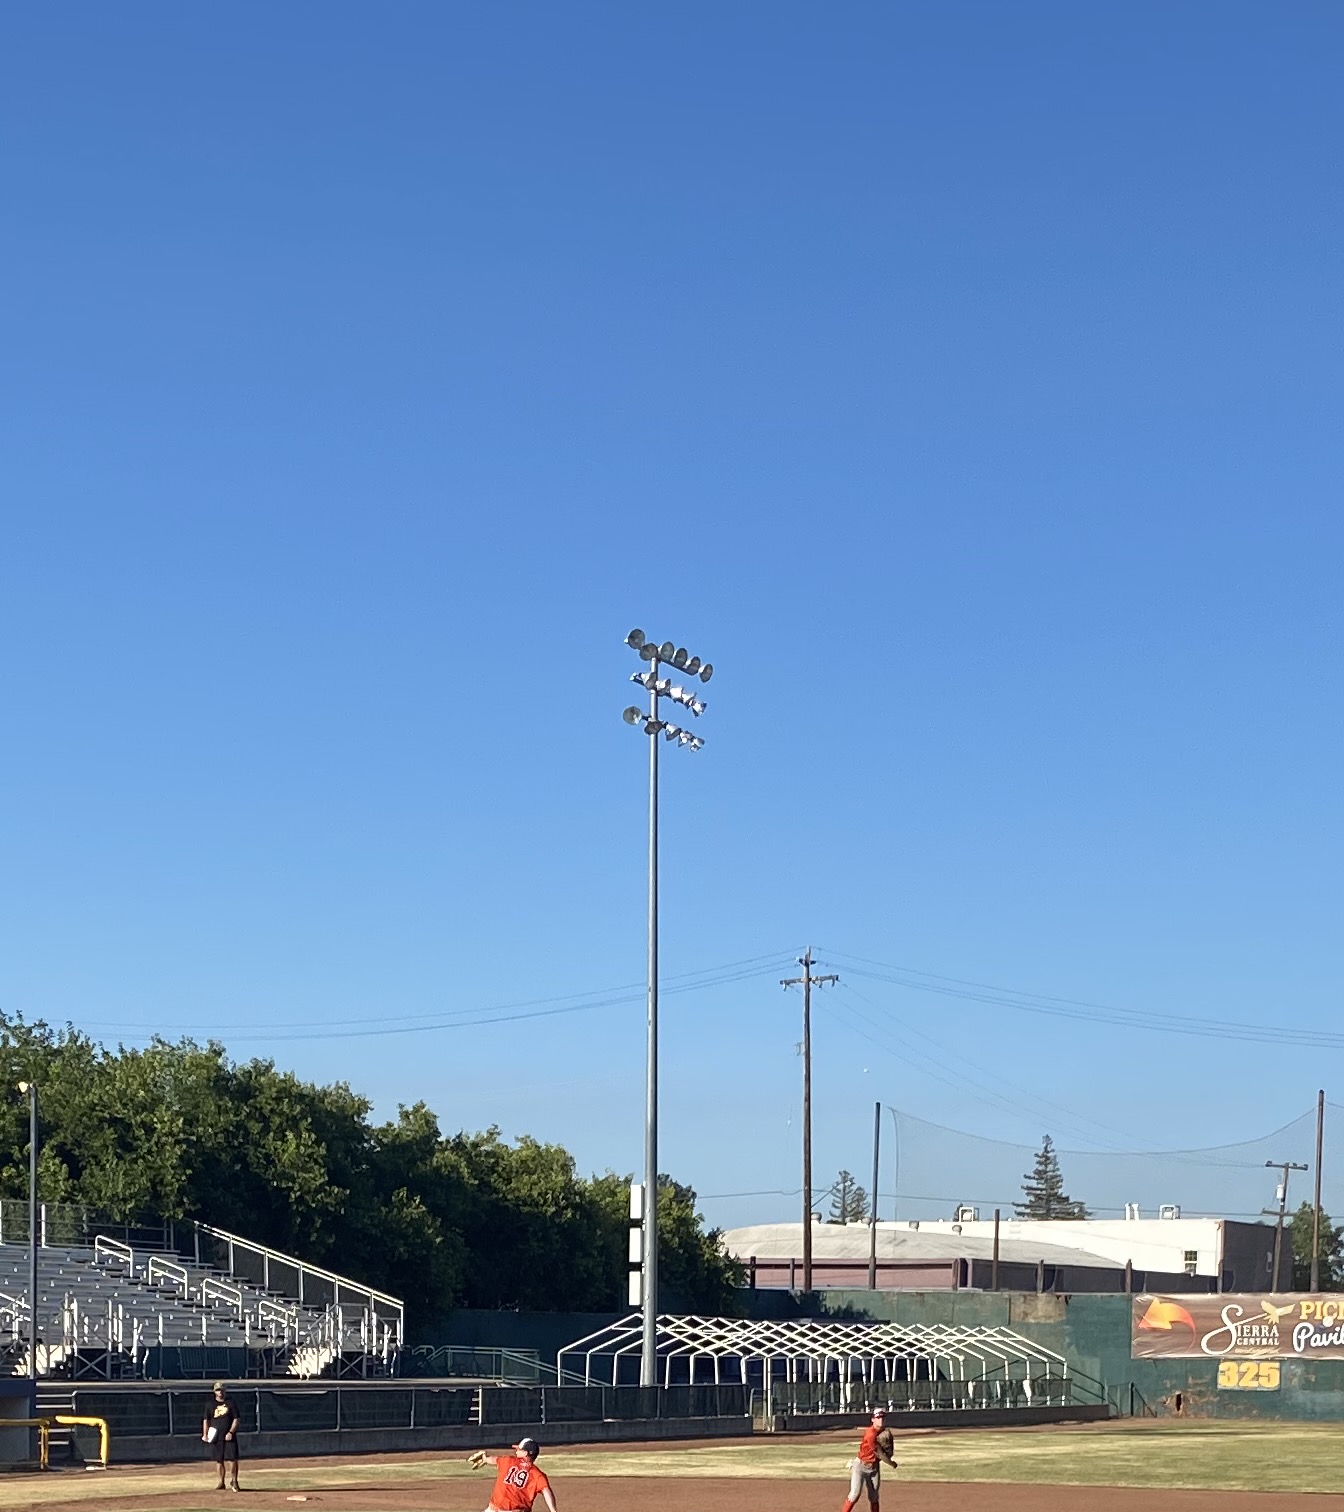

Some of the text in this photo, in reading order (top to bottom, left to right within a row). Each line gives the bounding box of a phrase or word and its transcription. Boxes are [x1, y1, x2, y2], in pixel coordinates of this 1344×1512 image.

[1236, 1338, 1280, 1346] CENTRAL
[1218, 1361, 1281, 1388] 325
[503, 1465, 529, 1489] 19
